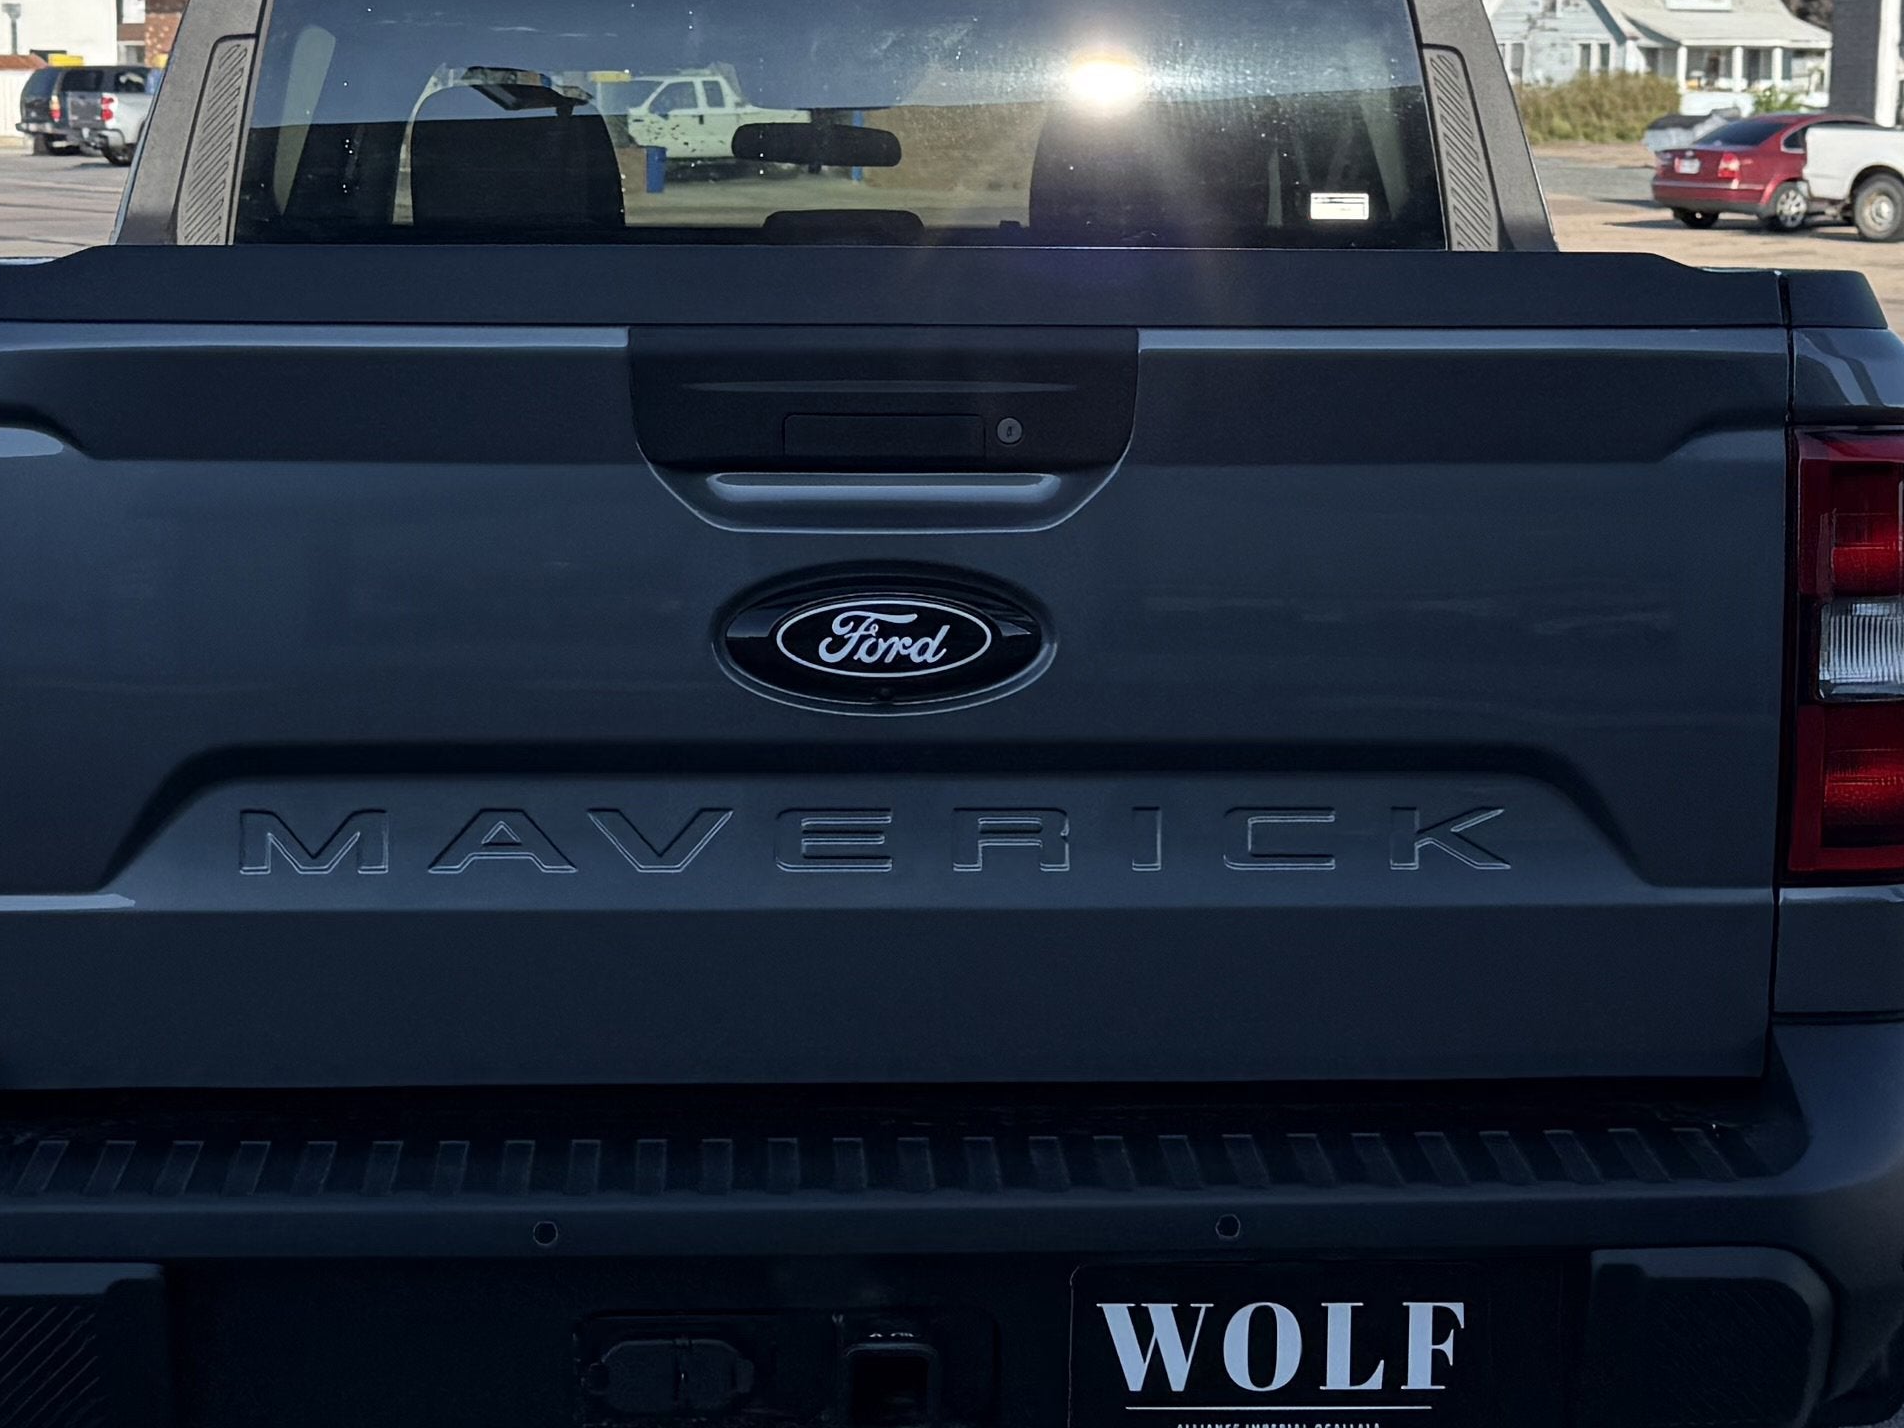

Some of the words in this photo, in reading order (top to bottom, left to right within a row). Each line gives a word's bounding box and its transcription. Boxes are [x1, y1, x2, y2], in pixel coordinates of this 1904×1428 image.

[818, 610, 951, 664] Ford
[237, 806, 1513, 875] MAVERICK
[1096, 1302, 1465, 1391] WOLF
